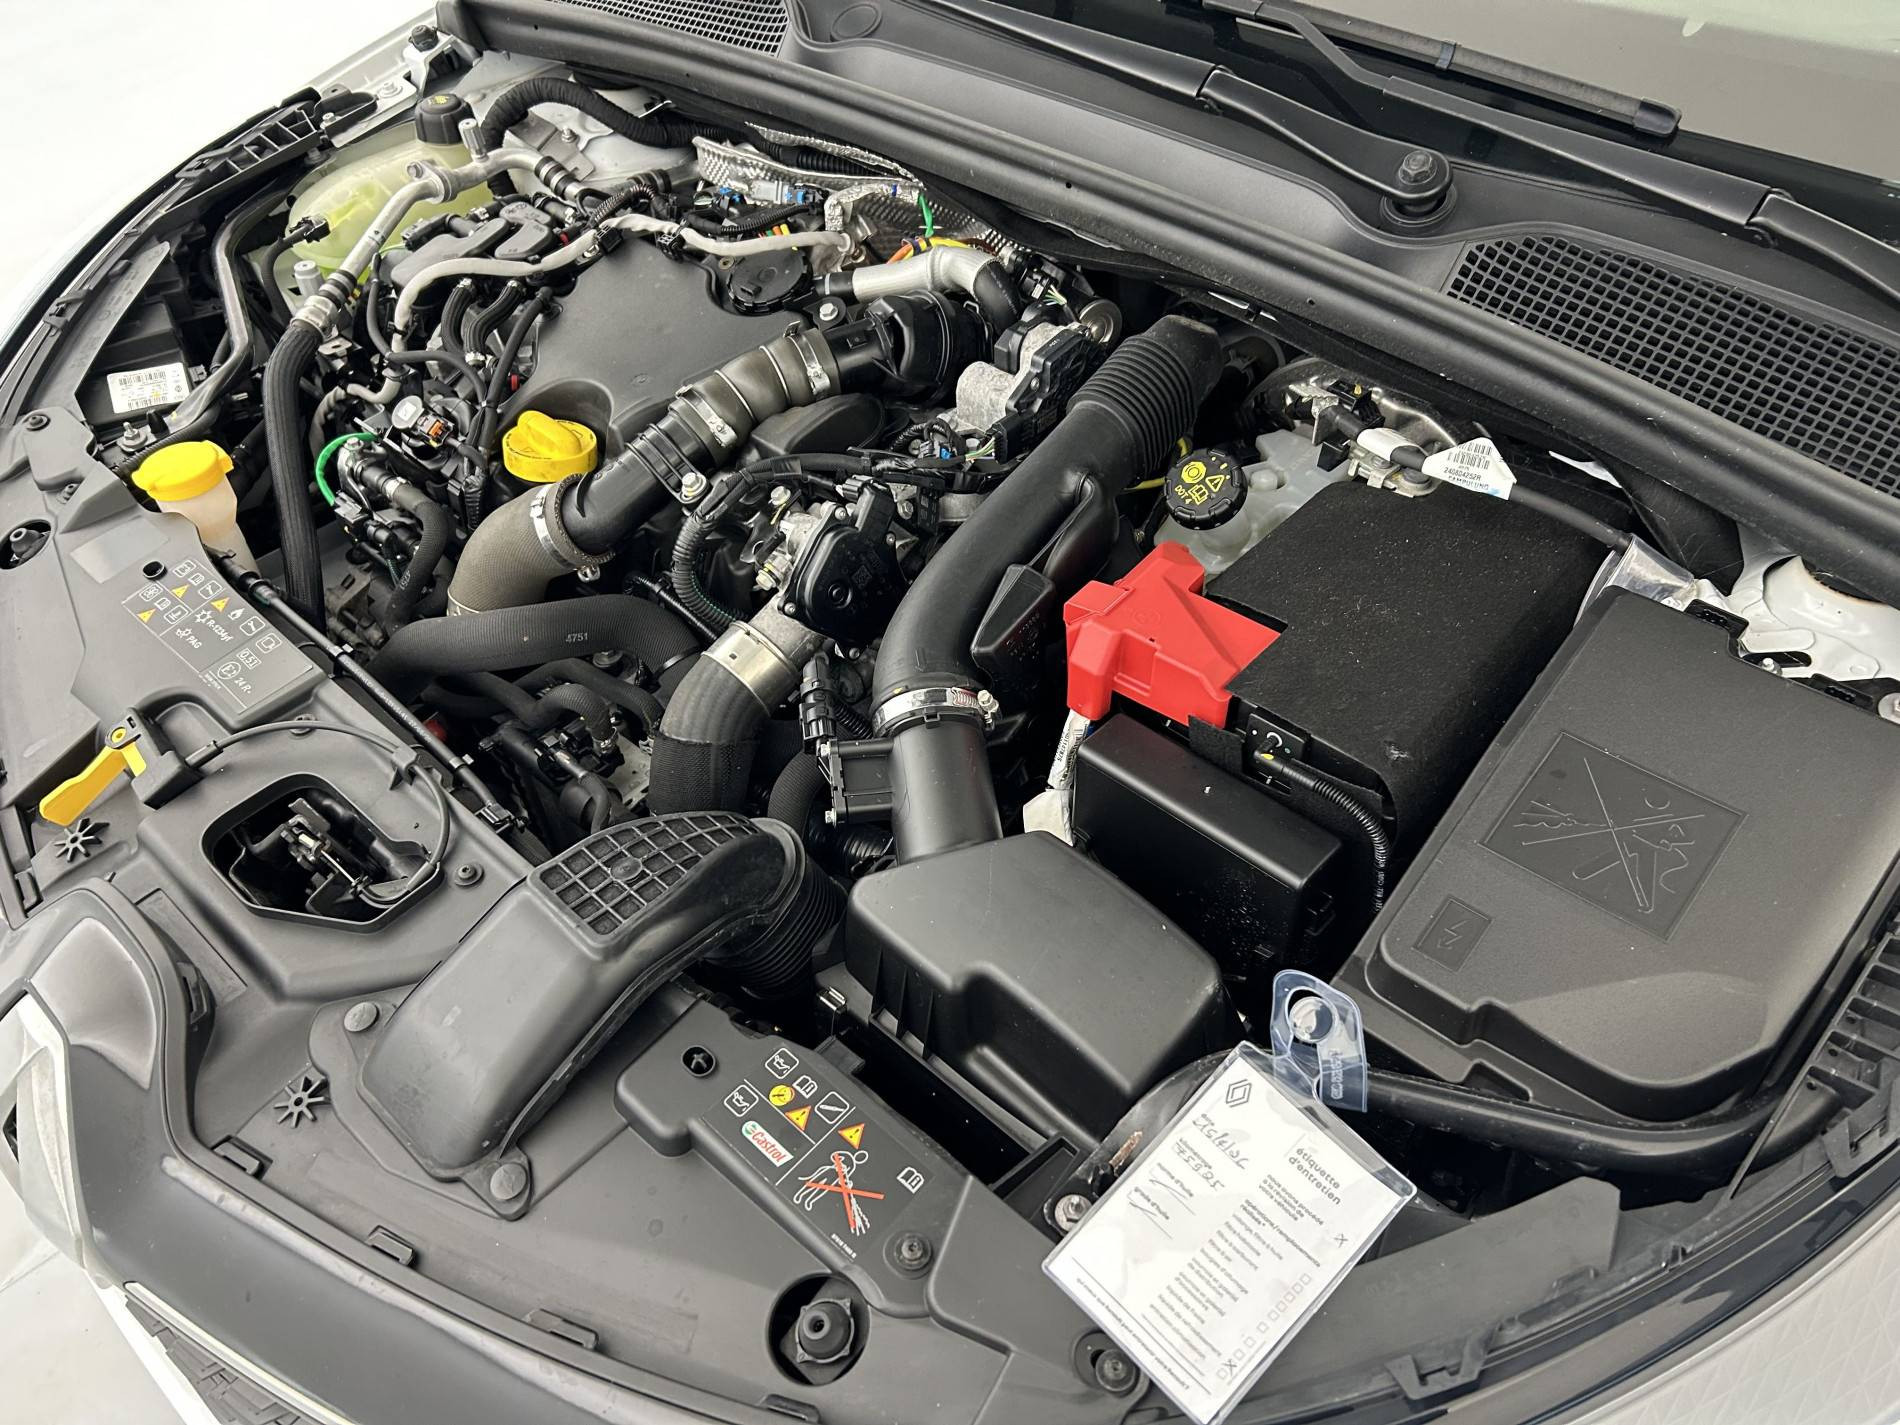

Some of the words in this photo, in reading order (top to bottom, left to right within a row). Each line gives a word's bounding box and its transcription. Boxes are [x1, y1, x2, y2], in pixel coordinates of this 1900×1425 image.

[1175, 485, 1189, 499] DOT
[186, 635, 203, 649] PAG
[565, 632, 588, 644] 4751
[751, 1131, 787, 1163] Castrol
[1295, 1145, 1341, 1190] étiquette
[1288, 1154, 1341, 1205] d'entretien
